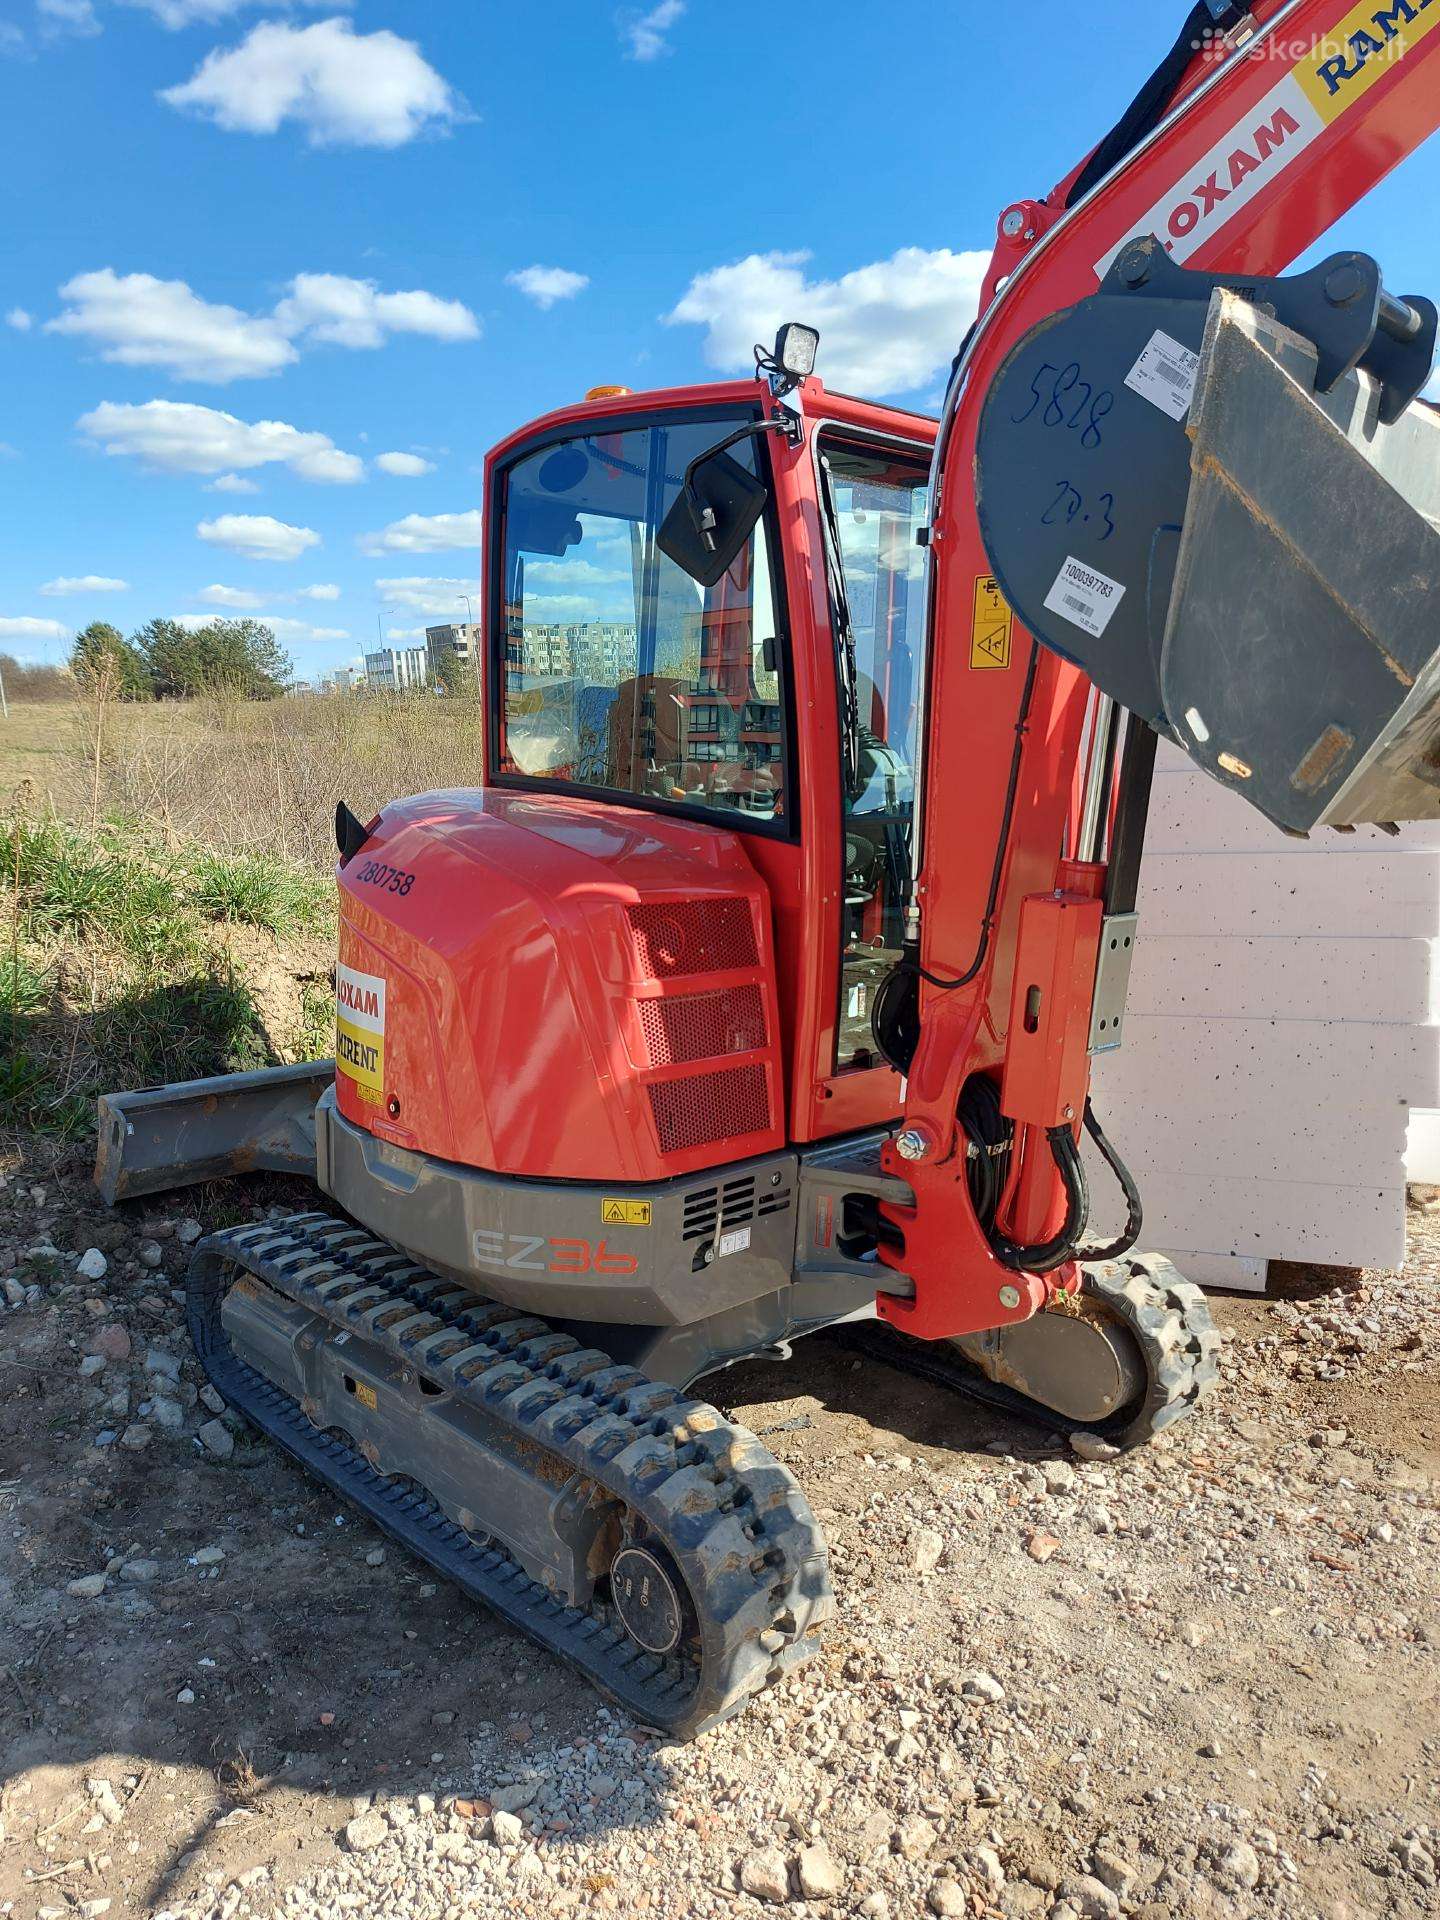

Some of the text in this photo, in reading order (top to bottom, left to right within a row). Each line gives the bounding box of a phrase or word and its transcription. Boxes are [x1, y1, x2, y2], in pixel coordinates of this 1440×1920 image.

[1316, 0, 1431, 96] RAM
[1011, 363, 1114, 449] 5828
[1065, 563, 1114, 598] 1000397783
[356, 860, 416, 896] 280758
[472, 1229, 639, 1274] EZ36
